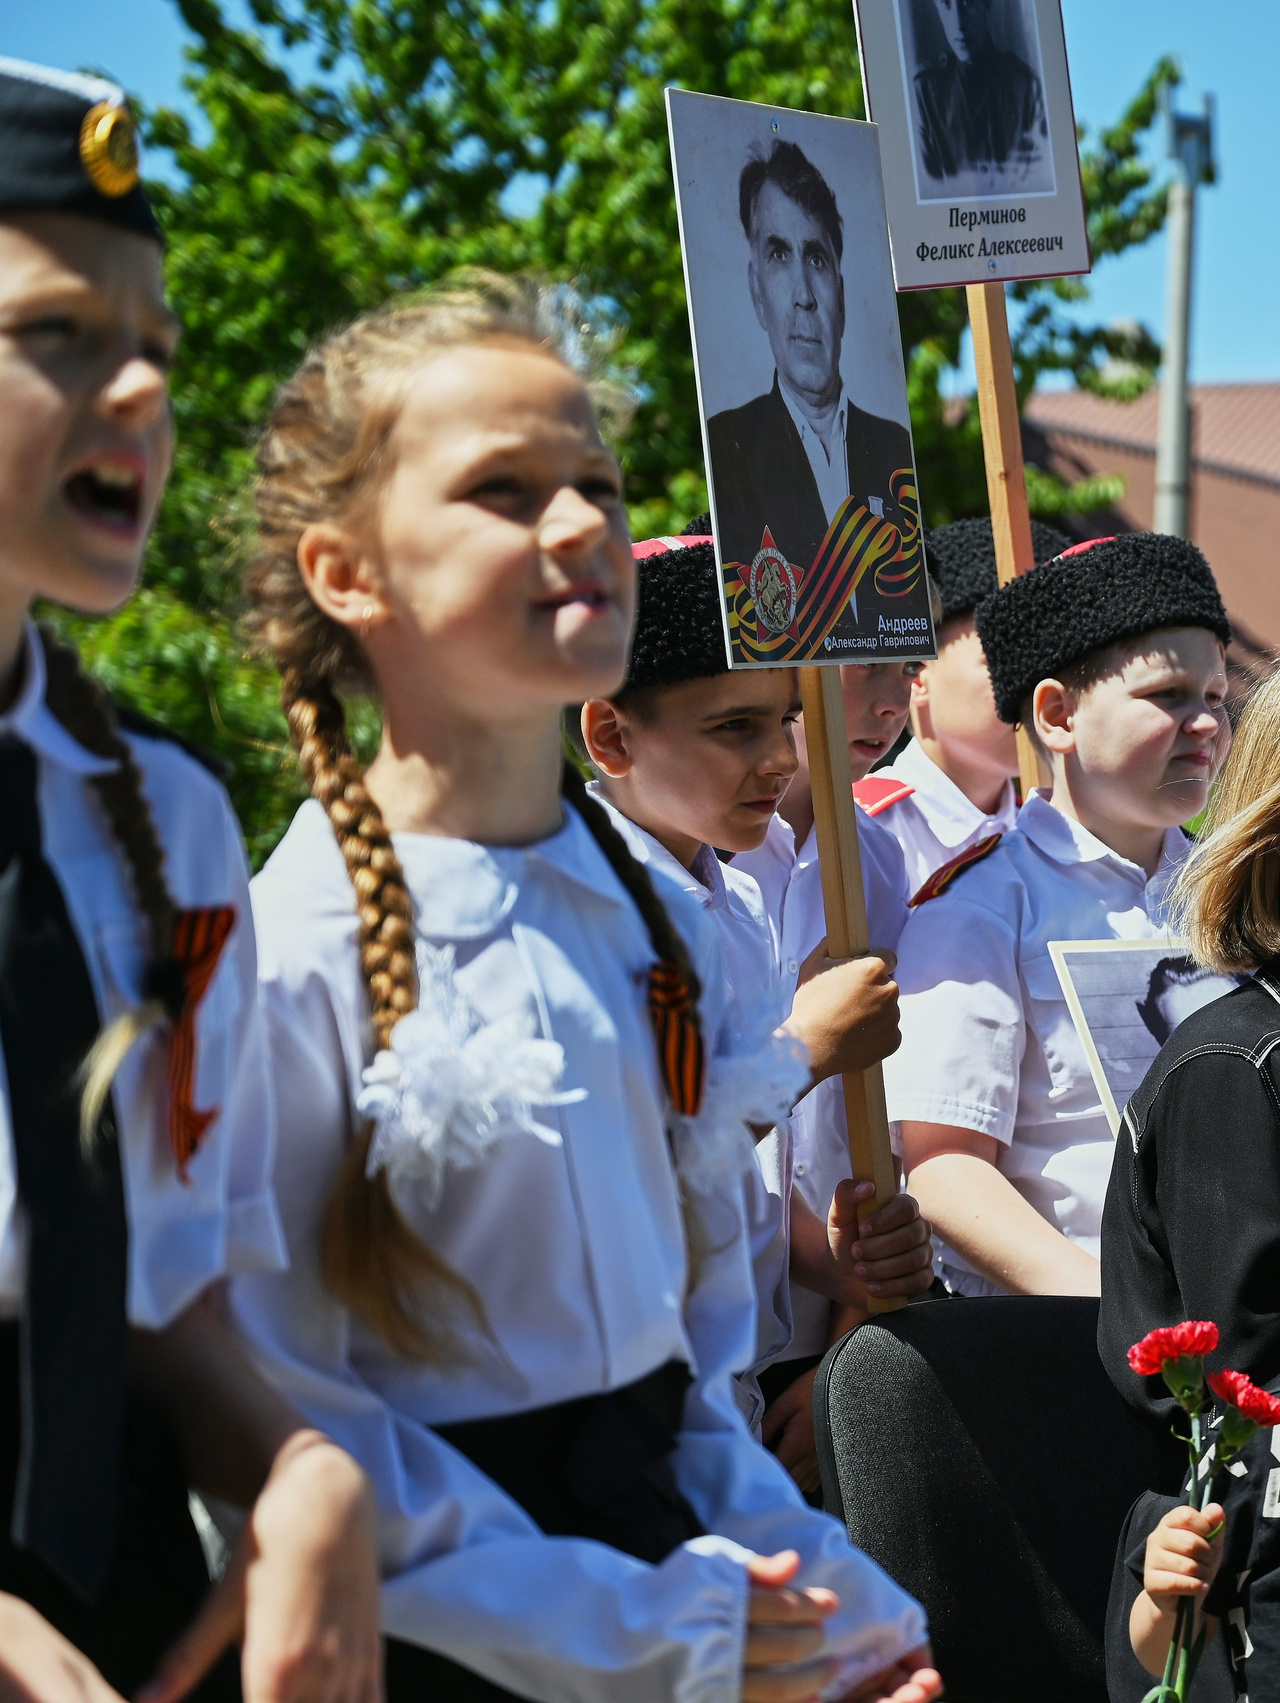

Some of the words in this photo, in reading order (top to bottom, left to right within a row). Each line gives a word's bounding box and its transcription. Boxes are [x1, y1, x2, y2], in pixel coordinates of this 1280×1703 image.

[949, 207, 1027, 232] Перминов
[916, 241, 975, 262] Феликс
[977, 235, 1064, 257] Алексеевич
[877, 614, 928, 634] Андреев
[831, 636, 878, 651] Александр
[879, 635, 930, 651] Гаврилович
